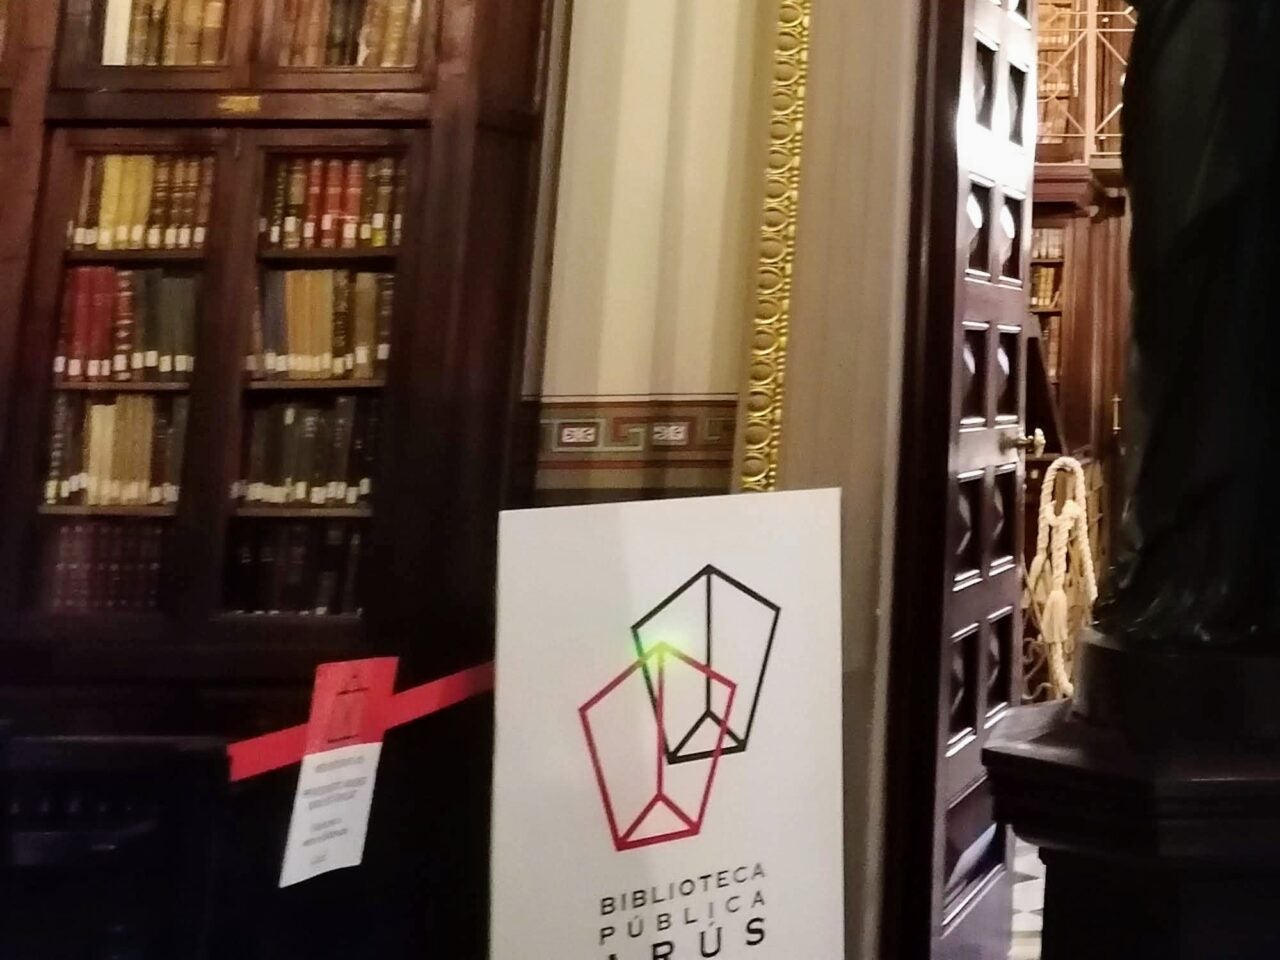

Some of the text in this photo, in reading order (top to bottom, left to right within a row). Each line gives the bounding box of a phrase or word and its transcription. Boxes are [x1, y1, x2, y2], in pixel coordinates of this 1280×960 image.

[600, 861, 766, 916] BIBLIOTECA
[598, 889, 766, 946] PÚBLICA
[606, 916, 767, 960] RÚS
